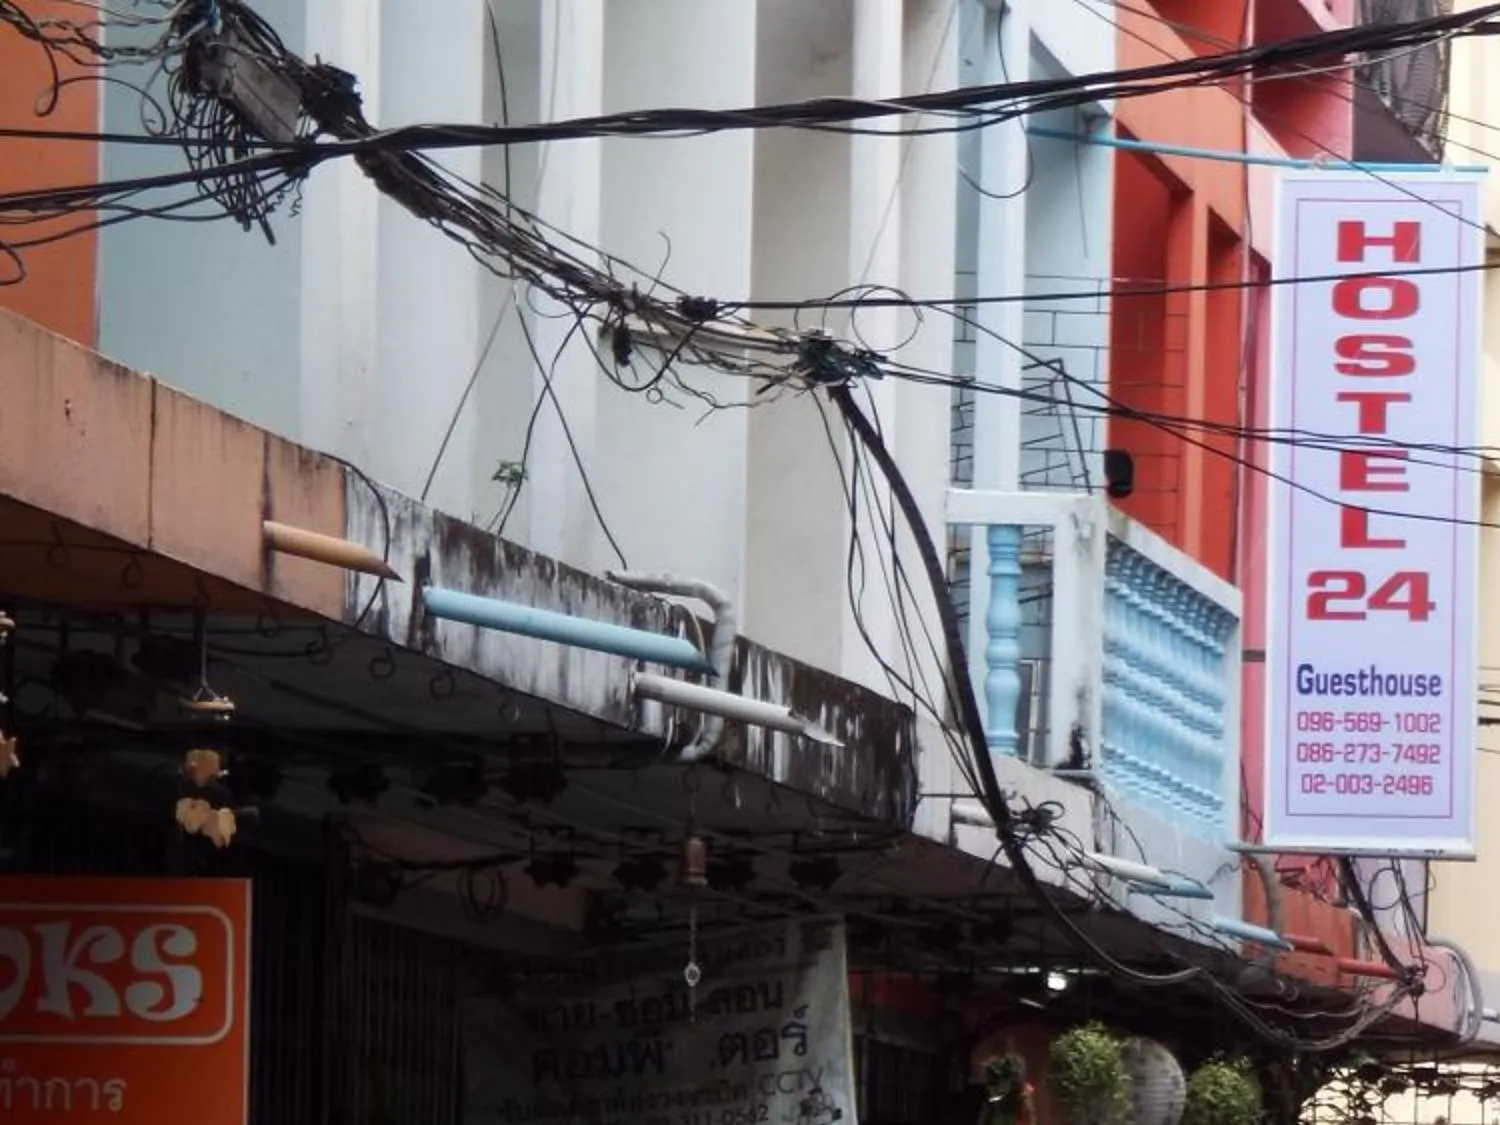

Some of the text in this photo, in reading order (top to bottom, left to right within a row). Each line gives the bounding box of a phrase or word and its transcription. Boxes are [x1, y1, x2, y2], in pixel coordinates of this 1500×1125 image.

[1330, 220, 1422, 550] HOSTEL
[1305, 569, 1436, 622] 24
[1296, 663, 1442, 697] Guesthouse
[1296, 711, 1441, 733] 096-569-1002
[1296, 742, 1441, 764] 086-273-7492
[1300, 773, 1434, 795] 02-003-2496
[758, 1066, 825, 1097] CCTV
